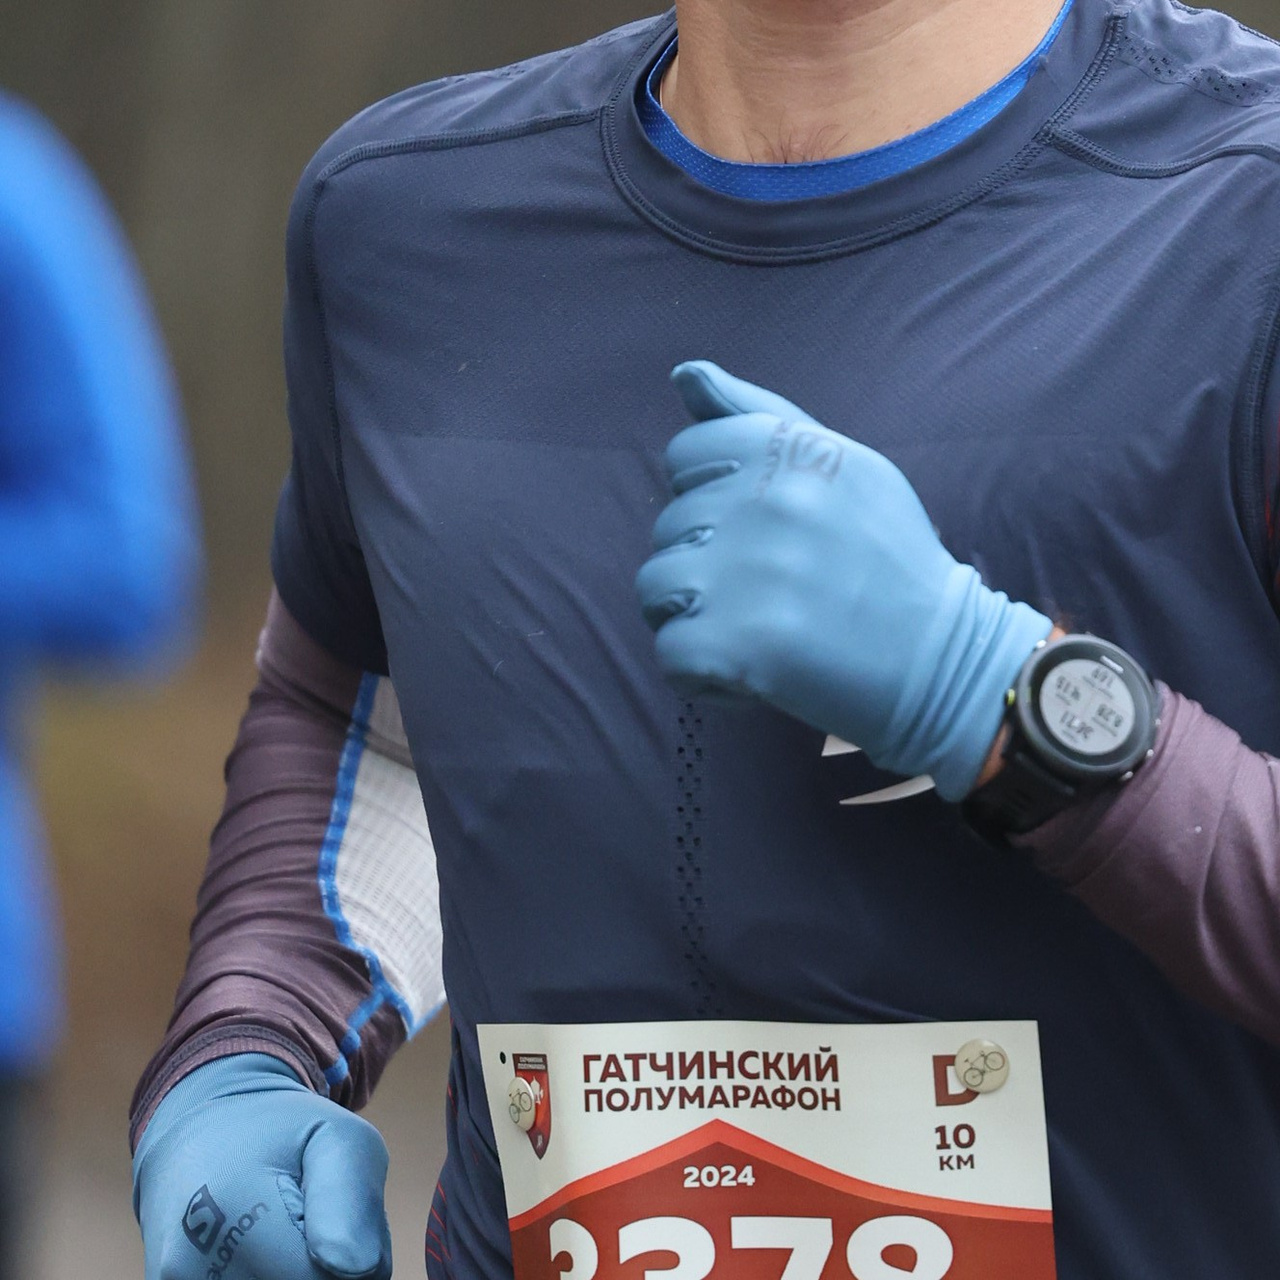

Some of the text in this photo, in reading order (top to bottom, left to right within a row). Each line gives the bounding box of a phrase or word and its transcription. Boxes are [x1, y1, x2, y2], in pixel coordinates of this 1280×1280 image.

[583, 1046, 840, 1083] ГАТЧИНСКИЙ
[584, 1084, 841, 1113] ПОЛУМАРАФОН
[935, 1123, 976, 1150] 10
[939, 1154, 975, 1171] КМ
[683, 1165, 756, 1189] 2024
